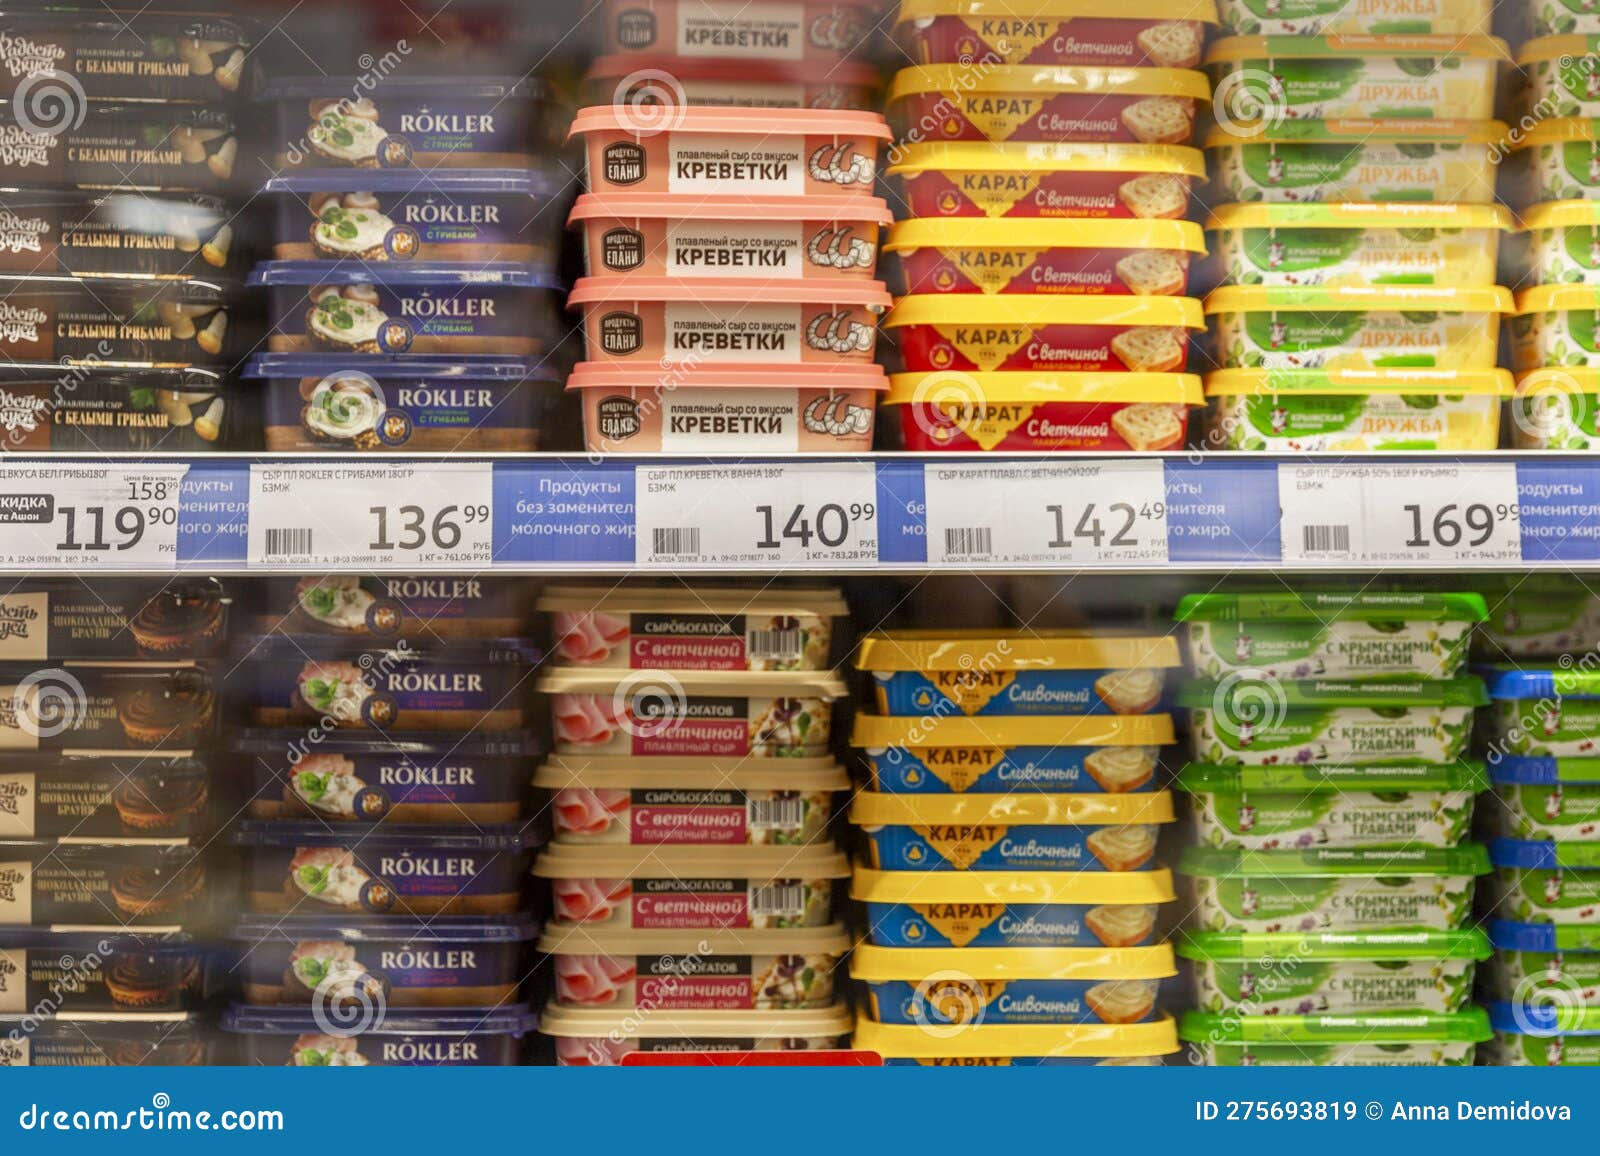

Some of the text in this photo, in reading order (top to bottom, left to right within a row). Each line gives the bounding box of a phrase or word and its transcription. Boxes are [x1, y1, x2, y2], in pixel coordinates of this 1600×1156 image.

[982, 20, 1049, 37] КАРАТ
[685, 28, 788, 48] КРЕВЕТКИ
[1358, 86, 1440, 102] ДРУЖБА
[966, 99, 1032, 115] КАРАТ
[677, 150, 728, 160] плавленый
[731, 152, 749, 163] сыр
[764, 153, 799, 162] вкусом
[677, 162, 787, 180] КРЕВЕТКИ
[1358, 167, 1440, 184] ДРУЖБА
[964, 174, 1029, 191] КАРАТ
[676, 236, 797, 249] плавленый сыр со вкусом
[676, 249, 786, 266] КРЕВЕТКИ
[960, 251, 1026, 267] КАРАТ
[674, 320, 796, 333] плавленый сыр со вкусом
[674, 332, 785, 350] КРЕВЕТКИ
[956, 329, 1022, 345] КАРАТ
[1360, 331, 1441, 348] ДРУЖБА
[671, 404, 723, 414] плавленый
[726, 406, 744, 416] сыр
[759, 406, 793, 415] вкусом
[956, 406, 1022, 421] КАРАТ
[54, 411, 169, 428] С БЕЛЫМИ ГРИБАМИ
[671, 416, 782, 433] КРЕВЕТКИ
[1361, 417, 1443, 434] ДРУЖБА
[263, 469, 414, 480] СЫР ПЛ ROKLER С ГРИБАМИ 180ГР
[649, 469, 783, 480] СЫР ВАННА 180Г
[938, 470, 988, 480] СЫР КАРАТ
[128, 483, 167, 500] 158
[262, 483, 290, 493] БЗМЖ
[539, 479, 621, 495] Продукты
[648, 483, 676, 493] БЗМЖ
[516, 500, 636, 514] без заменител
[11, 512, 39, 521] Ашон
[56, 507, 176, 551] 119 90
[369, 505, 489, 550] 136 99
[512, 524, 600, 536] молочного
[756, 504, 874, 548] 140 99
[1046, 503, 1164, 548] 142 49
[1188, 526, 1231, 539] жира
[1404, 504, 1519, 548] 169 99
[473, 542, 490, 550] РУБ
[473, 553, 490, 561] РУБ
[860, 551, 877, 560] РУБ
[652, 642, 740, 657] ветчиной
[1349, 653, 1413, 666] ТРАВАМИ
[938, 671, 1006, 687] КАРАТ
[1009, 684, 1090, 703] Сливочный
[1351, 739, 1415, 751] ТРАВАМИ
[927, 749, 996, 765] КАРАТ
[998, 762, 1079, 781] Сливочный
[636, 810, 741, 827] С ветчиной
[929, 825, 998, 841] КАРАТ
[1352, 823, 1417, 835] ТРАВАМИ
[1000, 839, 1081, 858] Сливочный
[637, 899, 742, 915] С ветчиной
[928, 904, 996, 919] КАРАТ
[1354, 907, 1419, 920] ТРАВАМИ
[998, 917, 1079, 936] Сливочный
[1352, 990, 1417, 1002] ТРАВАМИ
[998, 995, 1079, 1014] Сливочный
